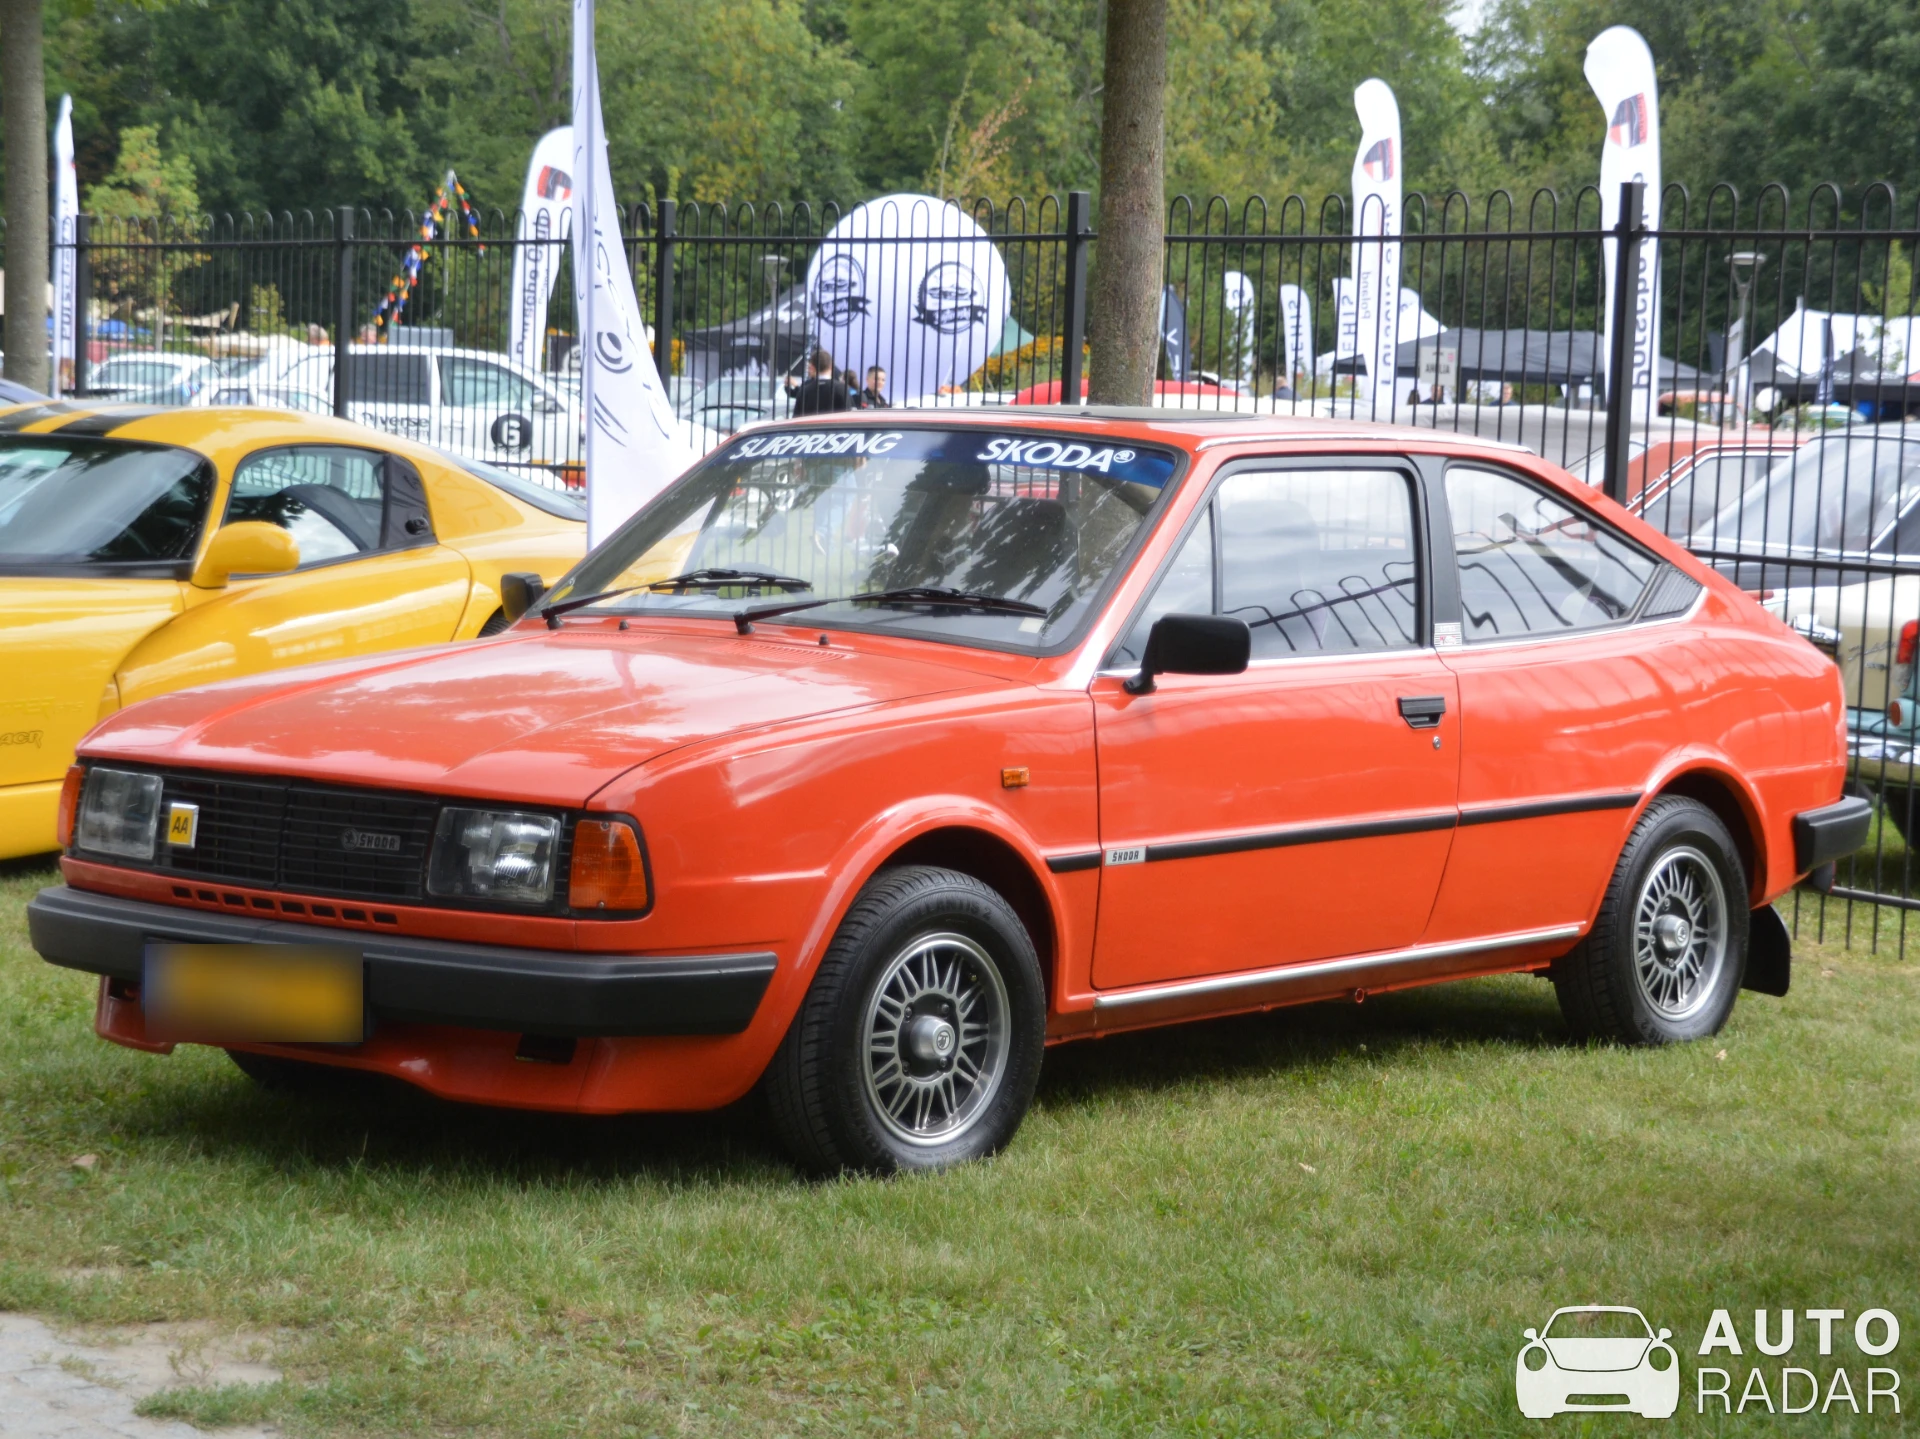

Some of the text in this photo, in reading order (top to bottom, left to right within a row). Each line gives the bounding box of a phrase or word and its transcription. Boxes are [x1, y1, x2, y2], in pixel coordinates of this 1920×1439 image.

[526, 215, 550, 263] Cub
[729, 433, 1115, 473] SURPRISING SKODA
[172, 815, 189, 835] AA
